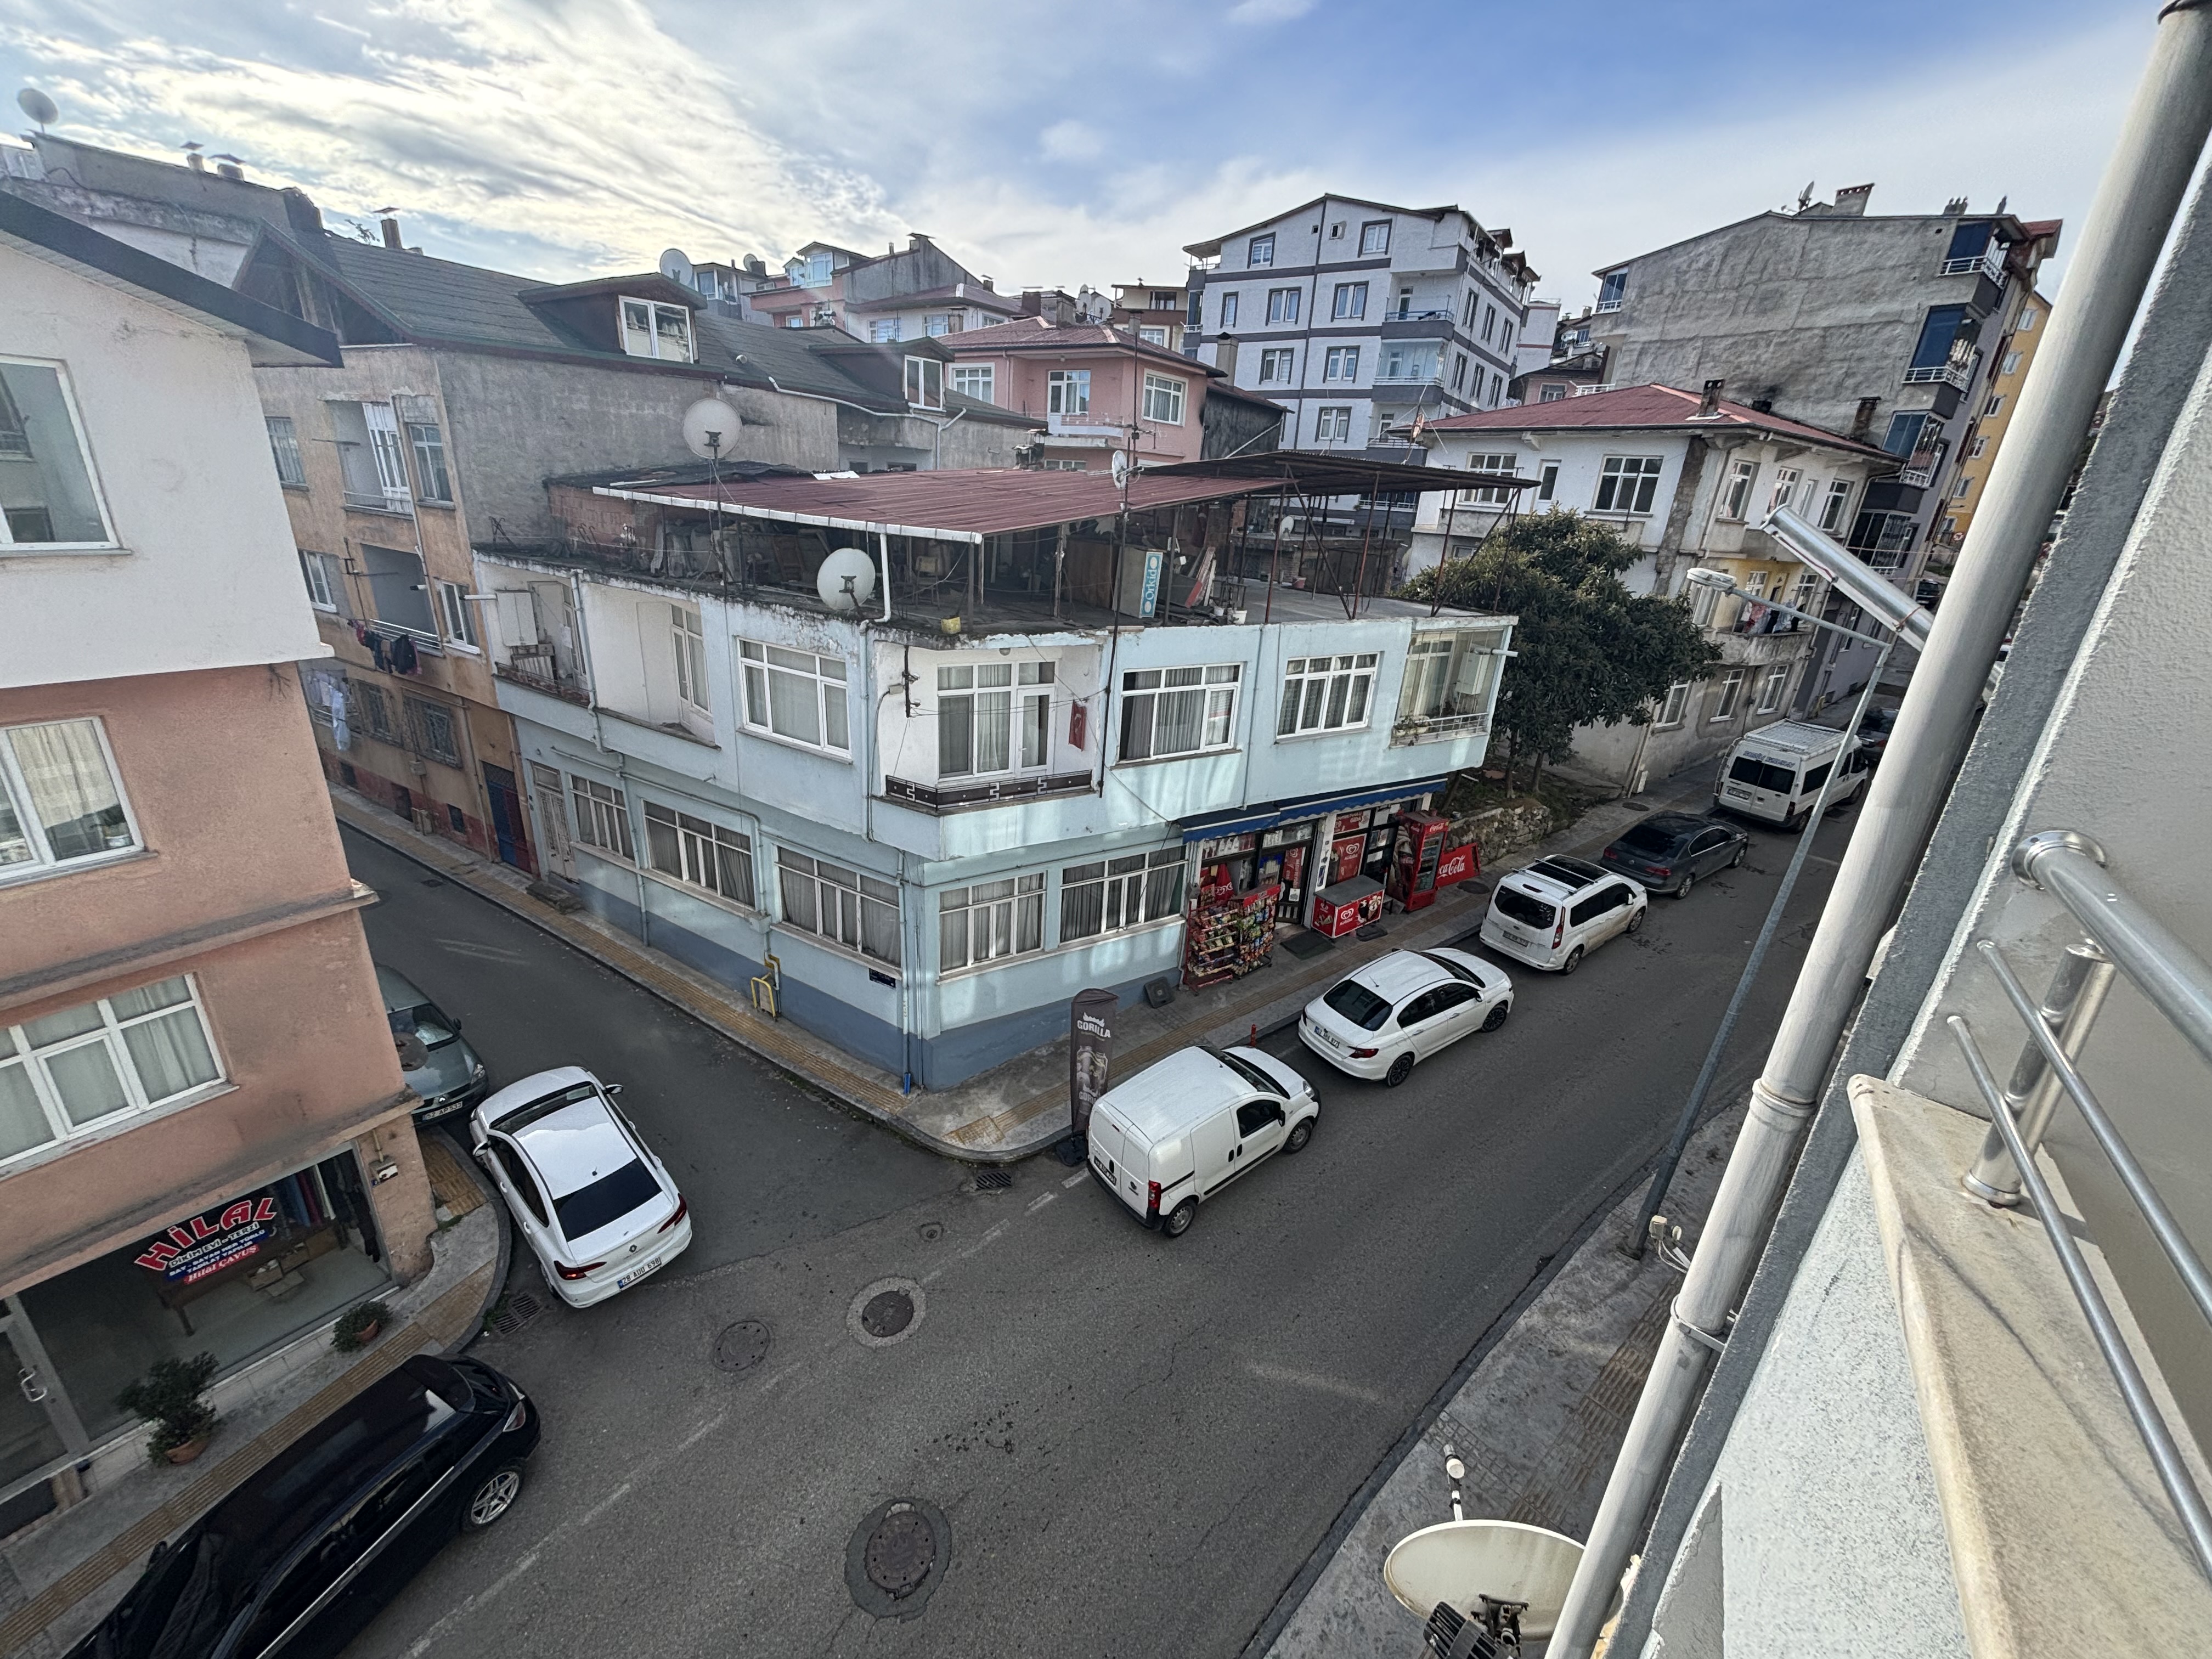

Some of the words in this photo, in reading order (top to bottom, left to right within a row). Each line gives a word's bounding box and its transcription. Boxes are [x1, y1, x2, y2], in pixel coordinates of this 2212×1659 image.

[1146, 569, 1157, 600] Orkid
[1077, 1020, 1111, 1038] GORILLA
[134, 1198, 276, 1271] HİLAL
[170, 1248, 203, 1268] DİKİM
[202, 1238, 222, 1252] EVİ
[228, 1221, 260, 1240] TERZİ
[218, 1245, 257, 1268] ÇAVUŞ
